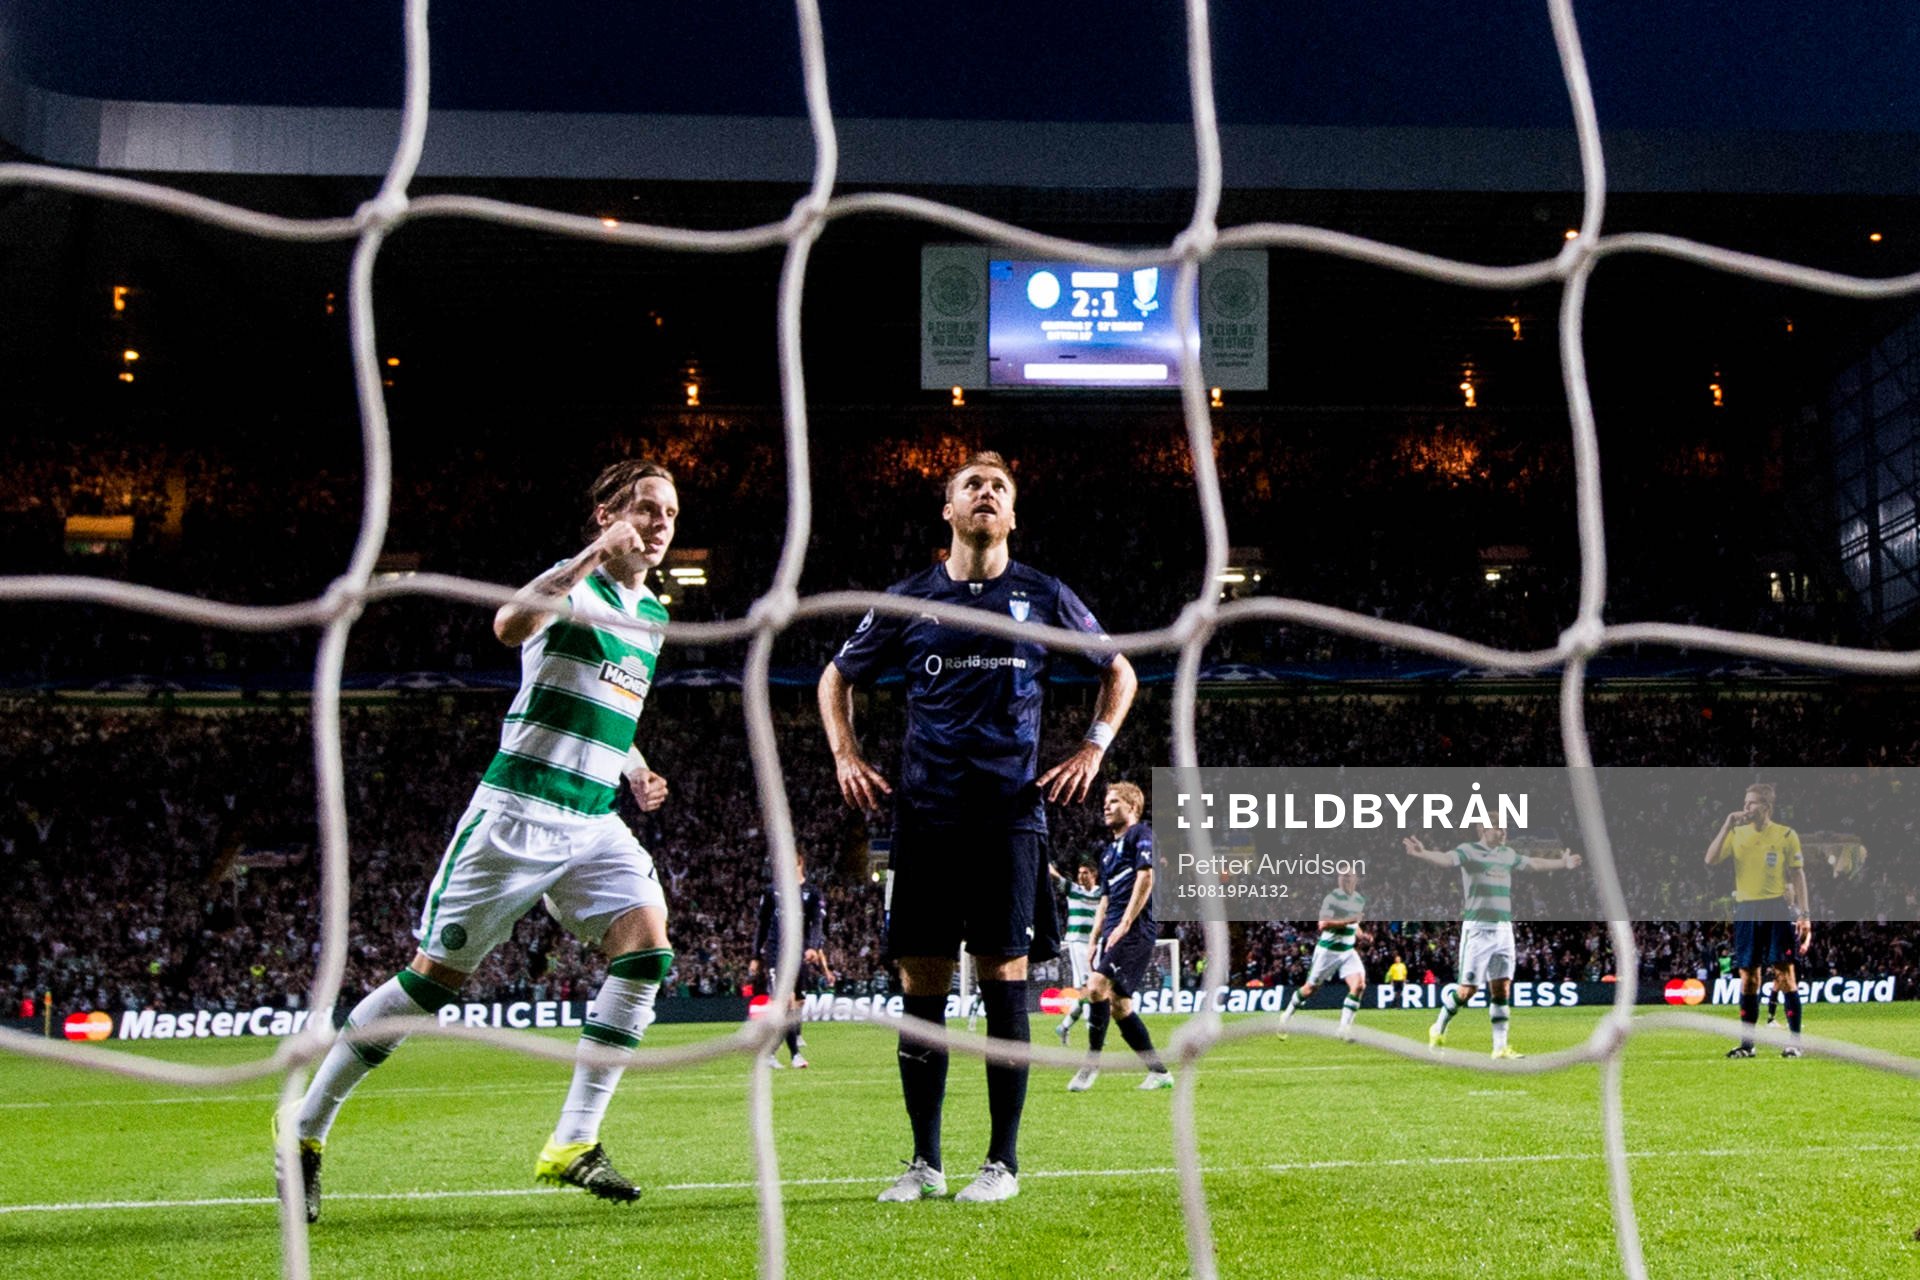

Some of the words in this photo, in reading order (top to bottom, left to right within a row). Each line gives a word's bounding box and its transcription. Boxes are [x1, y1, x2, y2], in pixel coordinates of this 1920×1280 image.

[1071, 289, 1118, 317] 2:1
[945, 654, 1027, 673] Rörläggaren
[1377, 981, 1579, 1008] PRICEESS
